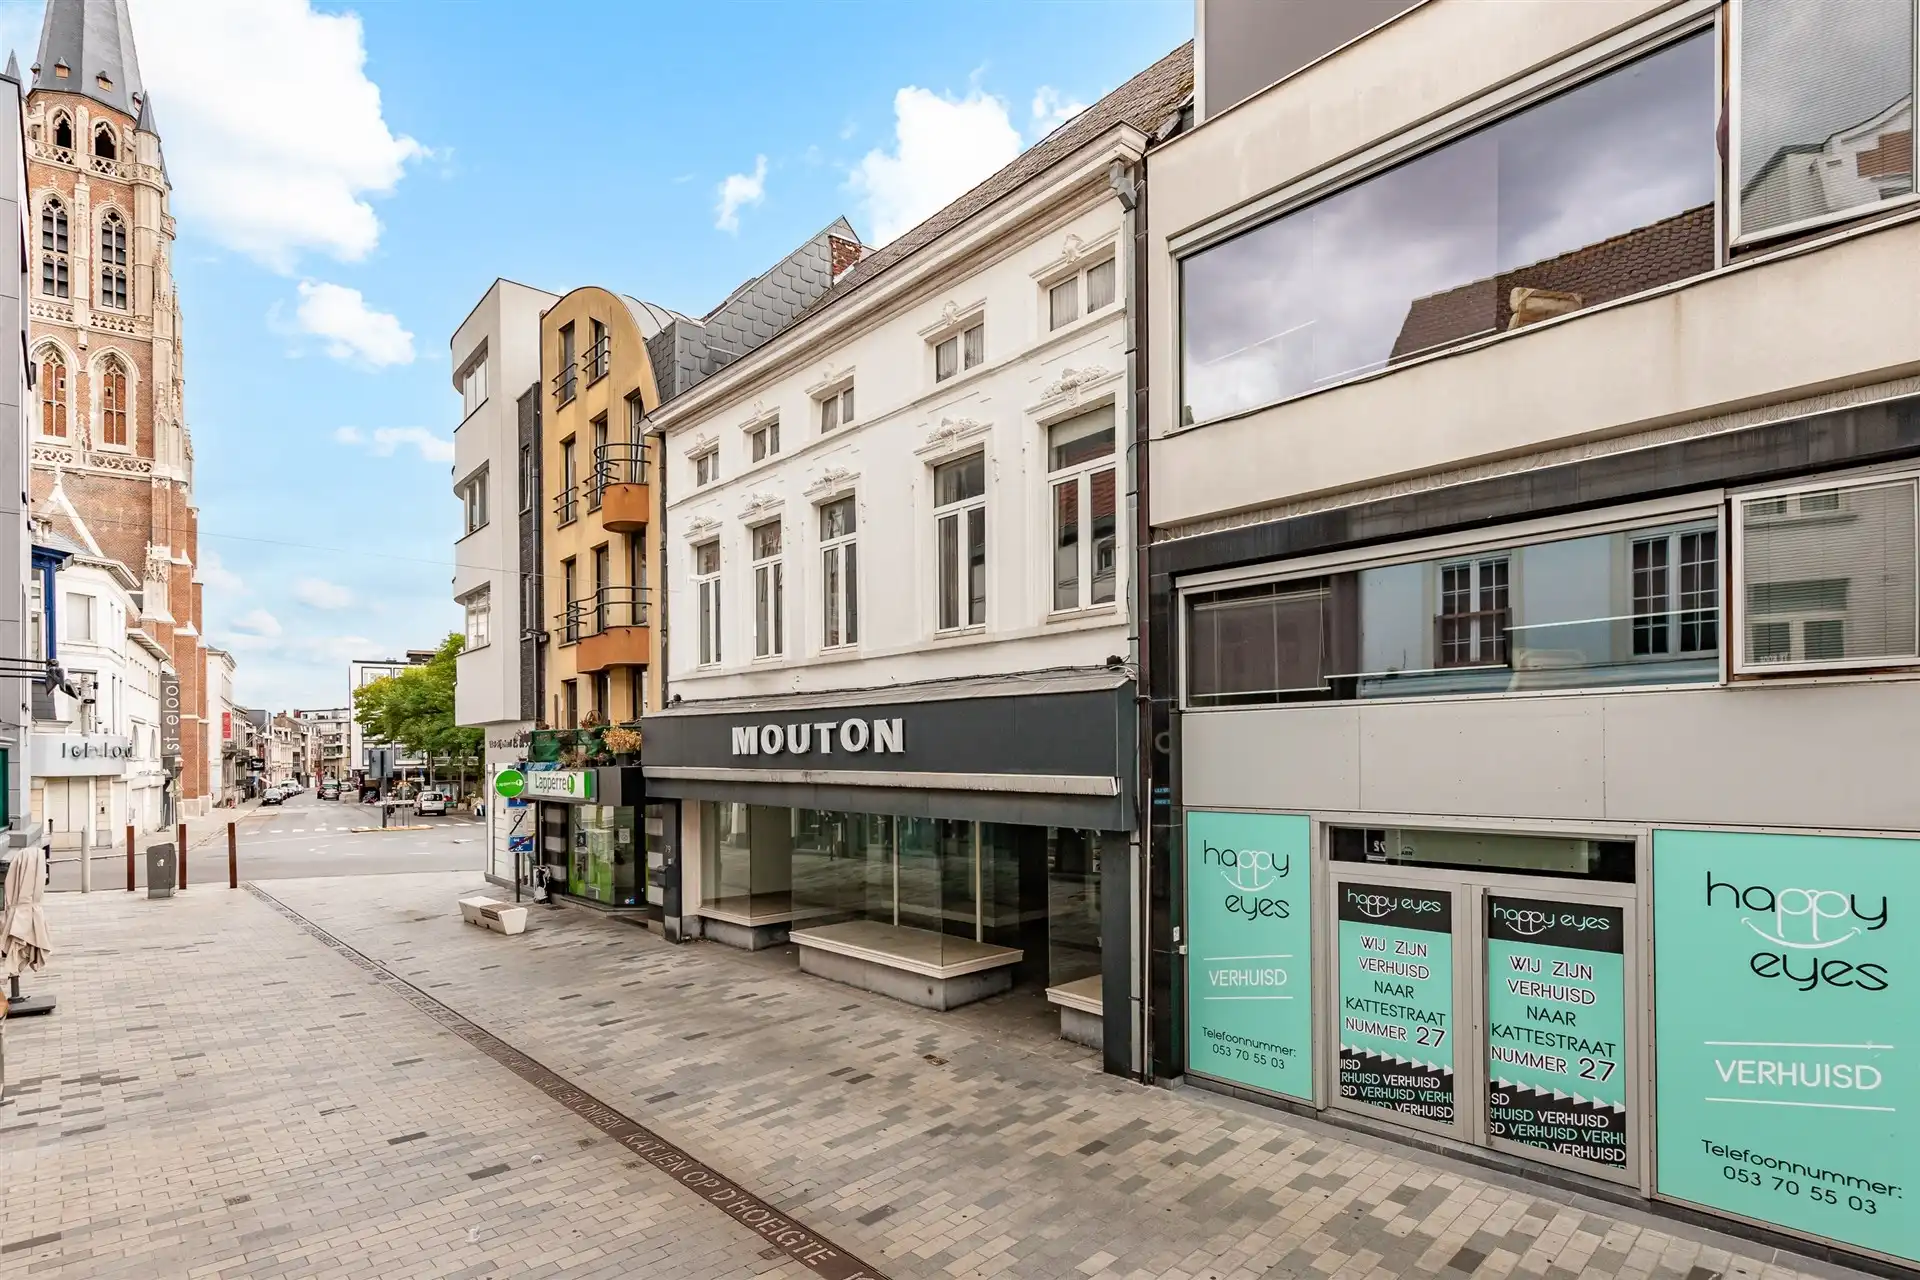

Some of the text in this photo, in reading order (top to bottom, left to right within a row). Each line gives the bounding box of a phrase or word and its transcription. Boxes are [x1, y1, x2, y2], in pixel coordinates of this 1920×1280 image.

[731, 717, 904, 755] MOUTON
[535, 773, 566, 793] Lapperre
[1203, 839, 1289, 886] happy
[1225, 894, 1290, 921] eyes
[1347, 888, 1442, 915] happy eyes
[1707, 870, 1888, 942] happy
[1493, 902, 1610, 932] happy eyes
[1360, 934, 1428, 958] WIJ ZIJN
[1208, 968, 1288, 987] VERHUISD
[1358, 956, 1430, 980] VERHUISD
[1509, 954, 1593, 981] WIJ ZIJN
[1750, 952, 1889, 992] eyes
[1374, 980, 1414, 999] NAAR
[1507, 978, 1596, 1006] VERHUISD
[1346, 996, 1446, 1026] KATTESTRAAT
[1527, 1005, 1577, 1027] NAAR
[1202, 1026, 1297, 1058] Telefoonnummer:
[1345, 1016, 1446, 1048] NUMMER 27
[1491, 1022, 1617, 1058] KATTESTRAAT
[1212, 1043, 1285, 1070] 053 70 55 03
[1490, 1045, 1617, 1082] NUMMER 27
[1383, 1074, 1441, 1089] VERHUISD
[1714, 1058, 1882, 1091] VERHUISD
[1359, 1085, 1416, 1101] VERHUISD
[1508, 1123, 1578, 1141] VERHUISD
[1537, 1110, 1609, 1128] VERHUISD
[682, 1170, 721, 1189] OP
[1700, 1138, 1903, 1199] Telefoonnummer:
[1723, 1165, 1878, 1215] 053 70 55 03
